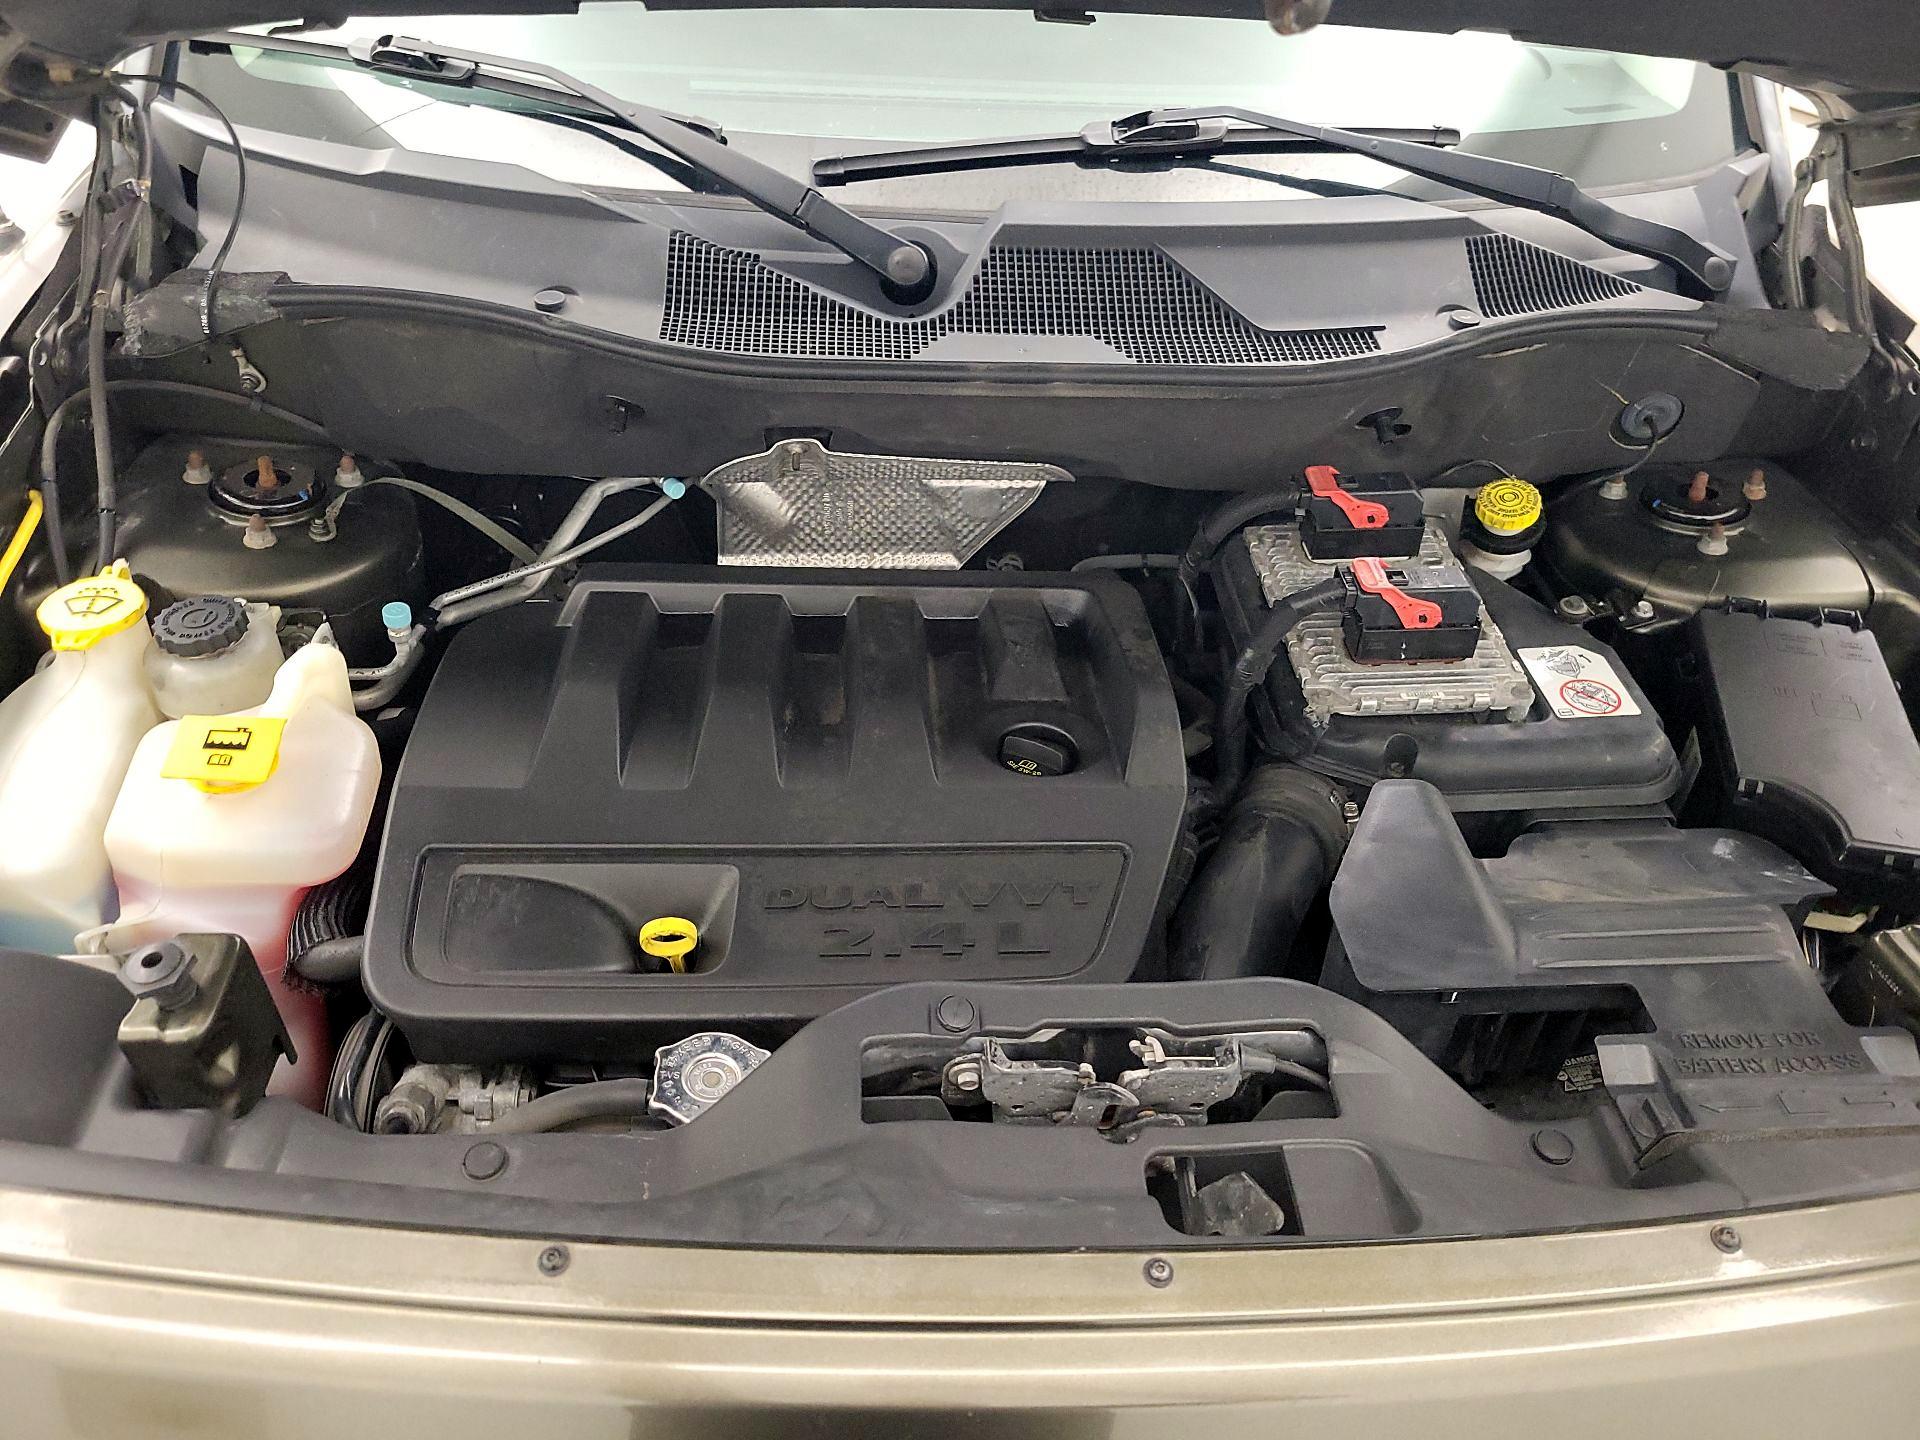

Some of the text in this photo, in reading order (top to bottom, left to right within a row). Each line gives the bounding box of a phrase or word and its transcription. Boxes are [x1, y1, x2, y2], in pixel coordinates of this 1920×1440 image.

[763, 881, 1095, 909] DUAL VVT
[1679, 1030, 1822, 1049] REMOVE FOR
[1564, 1054, 1598, 1067] DANGE
[1673, 1051, 1862, 1074] BATTERY ACCESS
